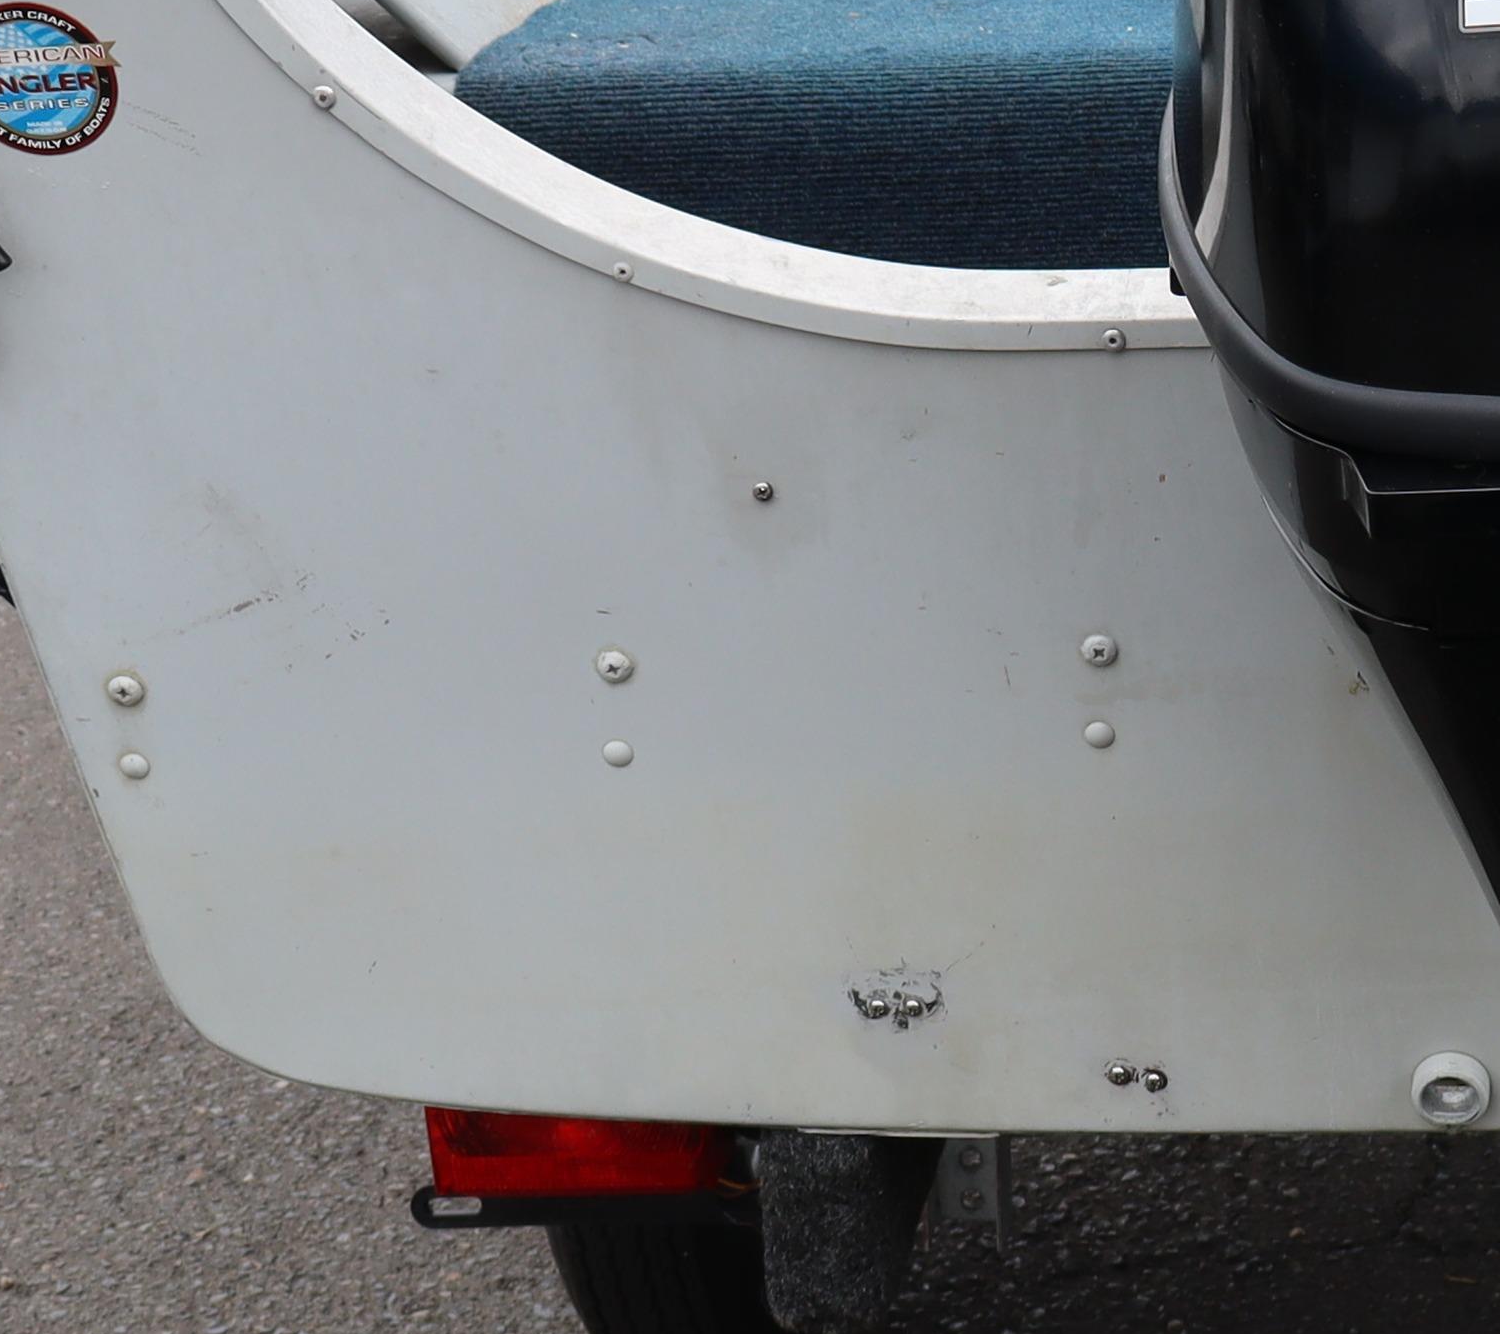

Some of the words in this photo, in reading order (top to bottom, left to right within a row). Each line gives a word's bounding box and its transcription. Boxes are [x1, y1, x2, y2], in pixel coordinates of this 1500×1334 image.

[27, 10, 77, 33] CRAFT
[8, 133, 62, 149] FAMILY
[65, 132, 83, 146] OF
[84, 97, 111, 136] BOATS
